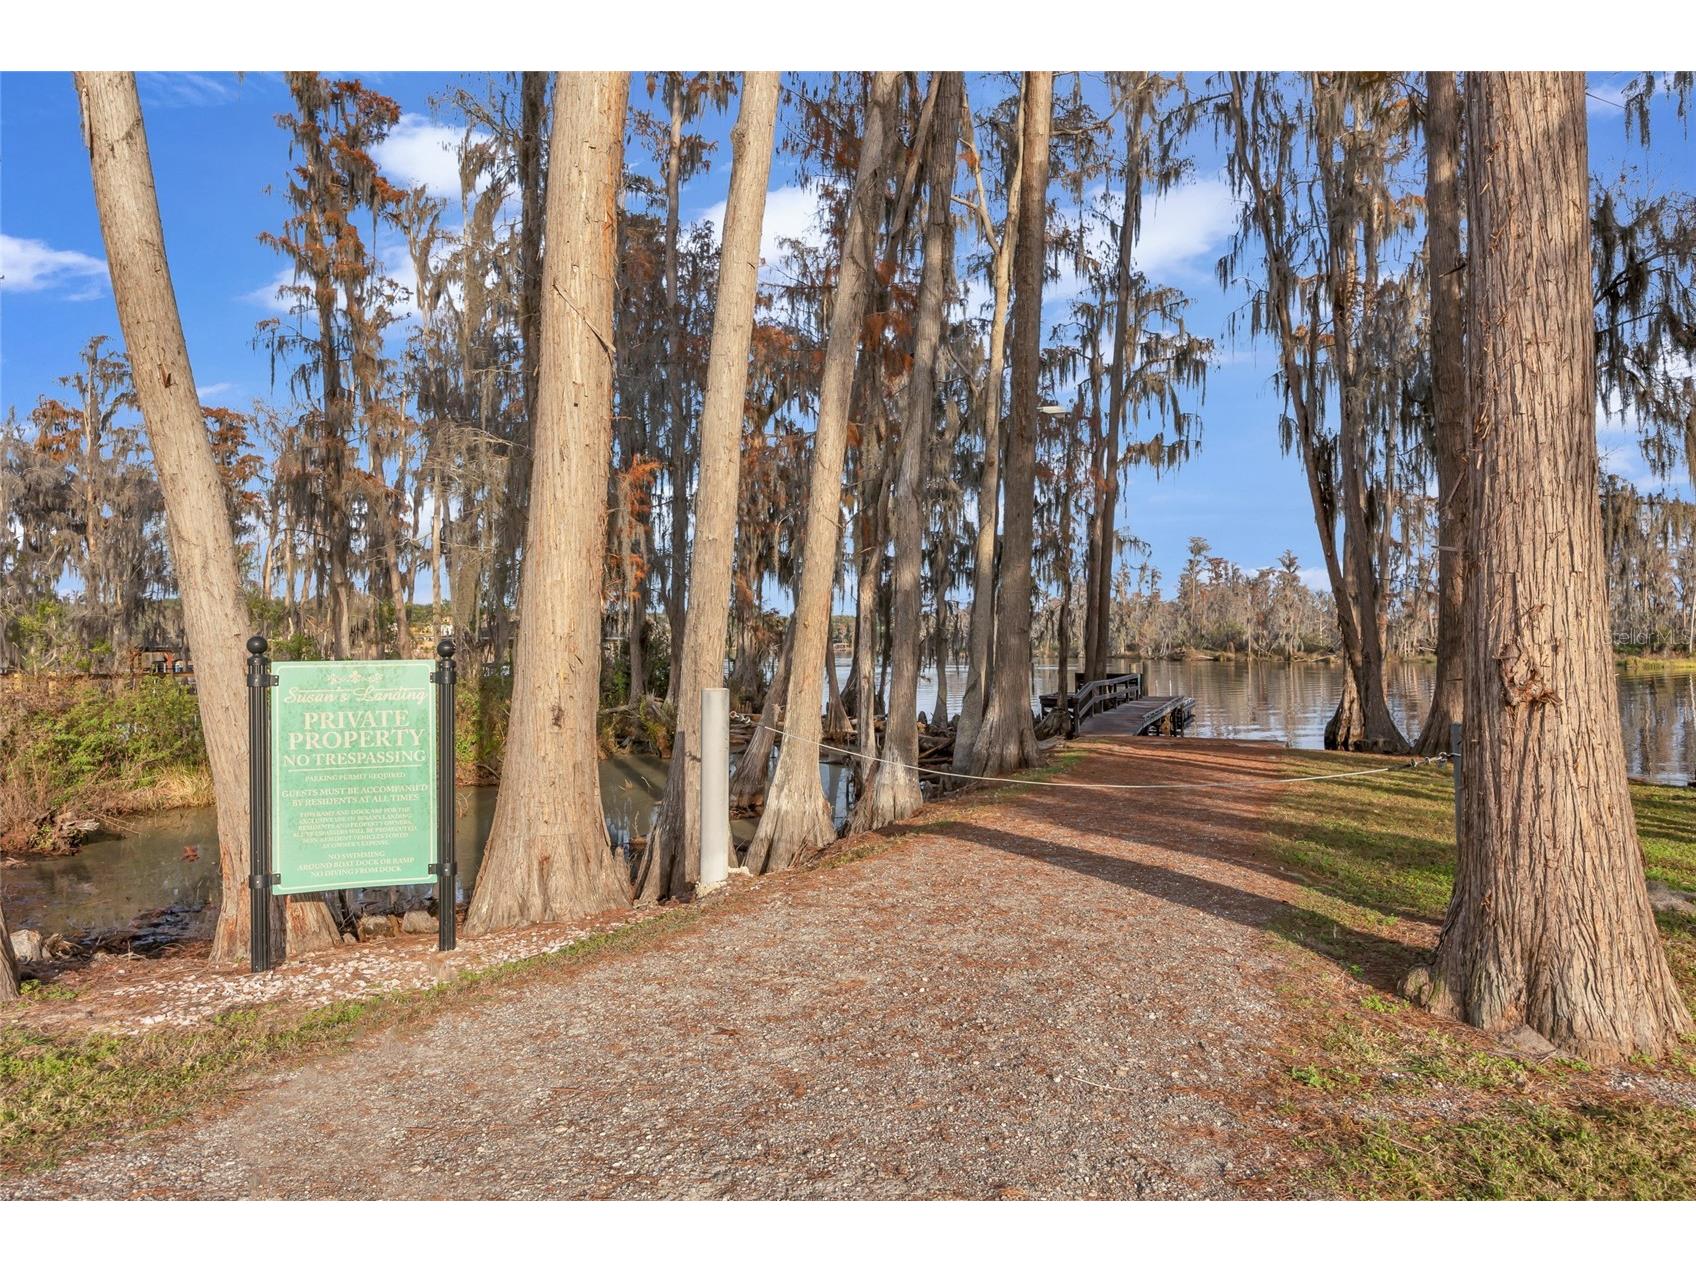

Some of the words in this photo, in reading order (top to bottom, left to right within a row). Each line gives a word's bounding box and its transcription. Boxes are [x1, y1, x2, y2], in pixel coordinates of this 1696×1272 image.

[284, 686, 348, 704] Susan's
[353, 685, 426, 704] Landing
[304, 710, 410, 730] PRIVATE
[287, 728, 424, 750] PROPERTY
[284, 754, 310, 767] NO
[311, 750, 426, 766] TRESPASSING
[305, 774, 338, 782] PARKING
[339, 773, 367, 781] PERMIT
[369, 772, 406, 780] REQUIRED
[281, 788, 318, 798] GUESTS
[319, 787, 345, 796] MUST
[347, 786, 359, 795] BE
[361, 784, 428, 794] ACCOMPANIED
[292, 799, 303, 807] BY
[304, 796, 357, 807] RESIDENTS
[373, 795, 388, 803] ALL
[390, 793, 420, 802] TIMES
[342, 851, 385, 859] SWIMMING
[297, 863, 332, 871] AROUND
[334, 861, 355, 869] BOAT
[355, 859, 380, 867] DOCK
[380, 858, 391, 866] OR
[391, 857, 415, 865] RAMP
[323, 869, 354, 877] DIVING
[354, 867, 378, 875] FROM
[378, 865, 402, 873] DOCK
